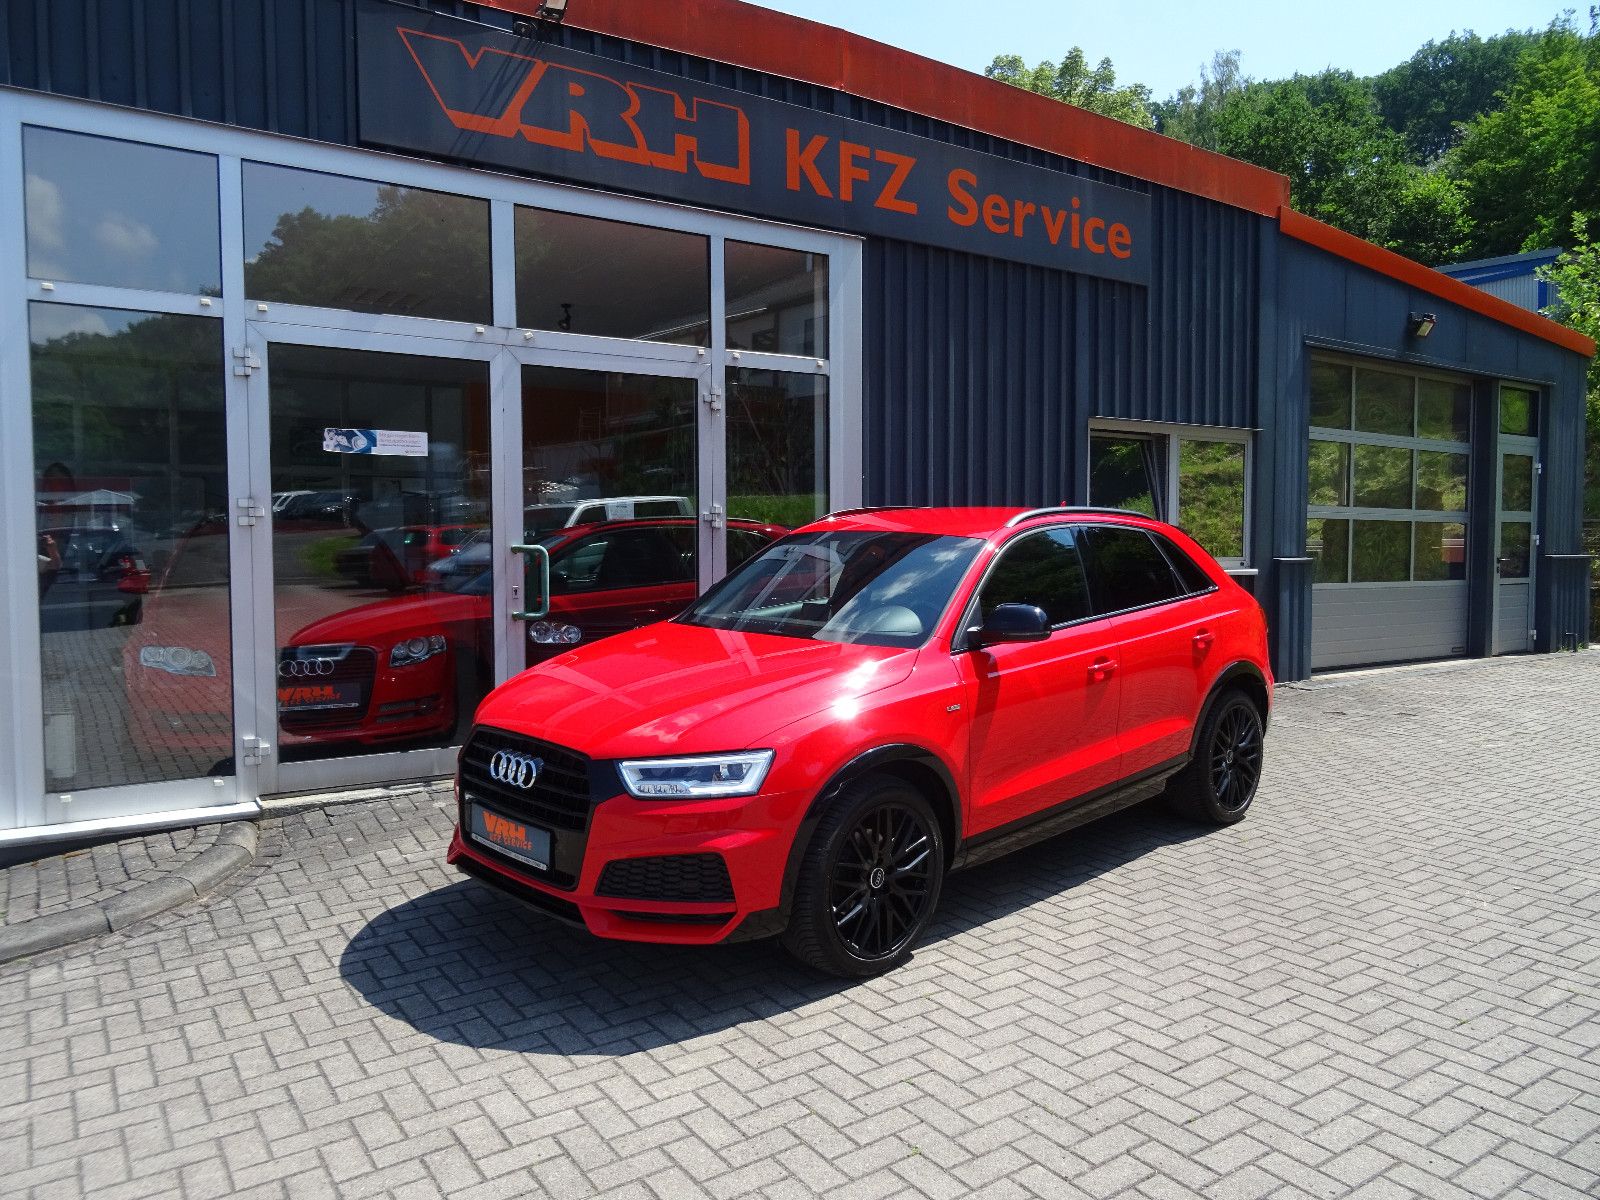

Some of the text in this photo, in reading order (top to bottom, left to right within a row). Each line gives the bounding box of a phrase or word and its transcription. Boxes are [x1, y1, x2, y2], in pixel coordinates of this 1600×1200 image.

[397, 27, 1132, 259] VRH KFZ Service
[482, 810, 527, 841] VRH
